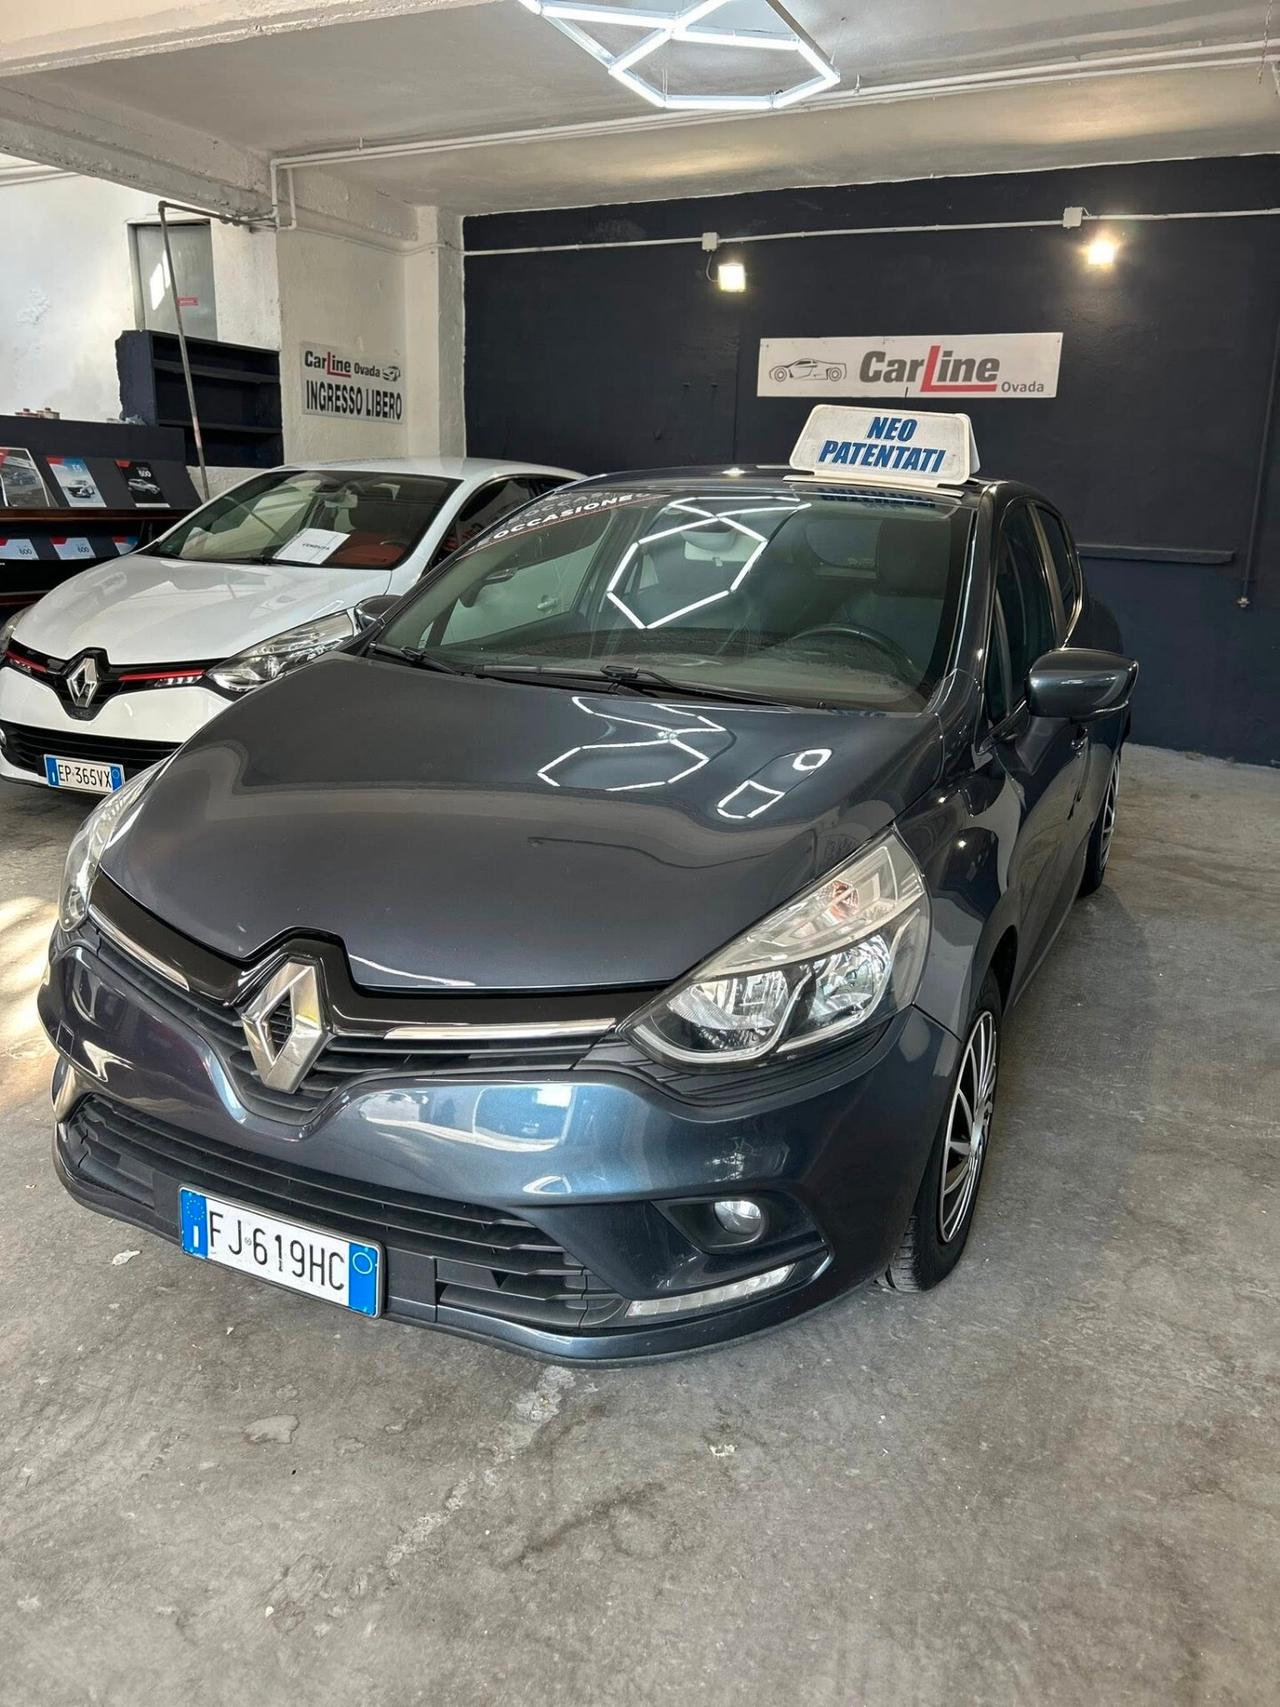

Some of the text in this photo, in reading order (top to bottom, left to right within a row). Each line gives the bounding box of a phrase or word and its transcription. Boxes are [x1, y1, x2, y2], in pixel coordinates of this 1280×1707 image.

[304, 350, 381, 378] CarLine Ovada
[859, 345, 1045, 393] CarLine Ovada
[306, 379, 403, 420] INGRESSO LIBERO
[866, 416, 918, 442] NEO
[817, 440, 947, 473] PATENTATI
[493, 494, 633, 540] OCCASIONE
